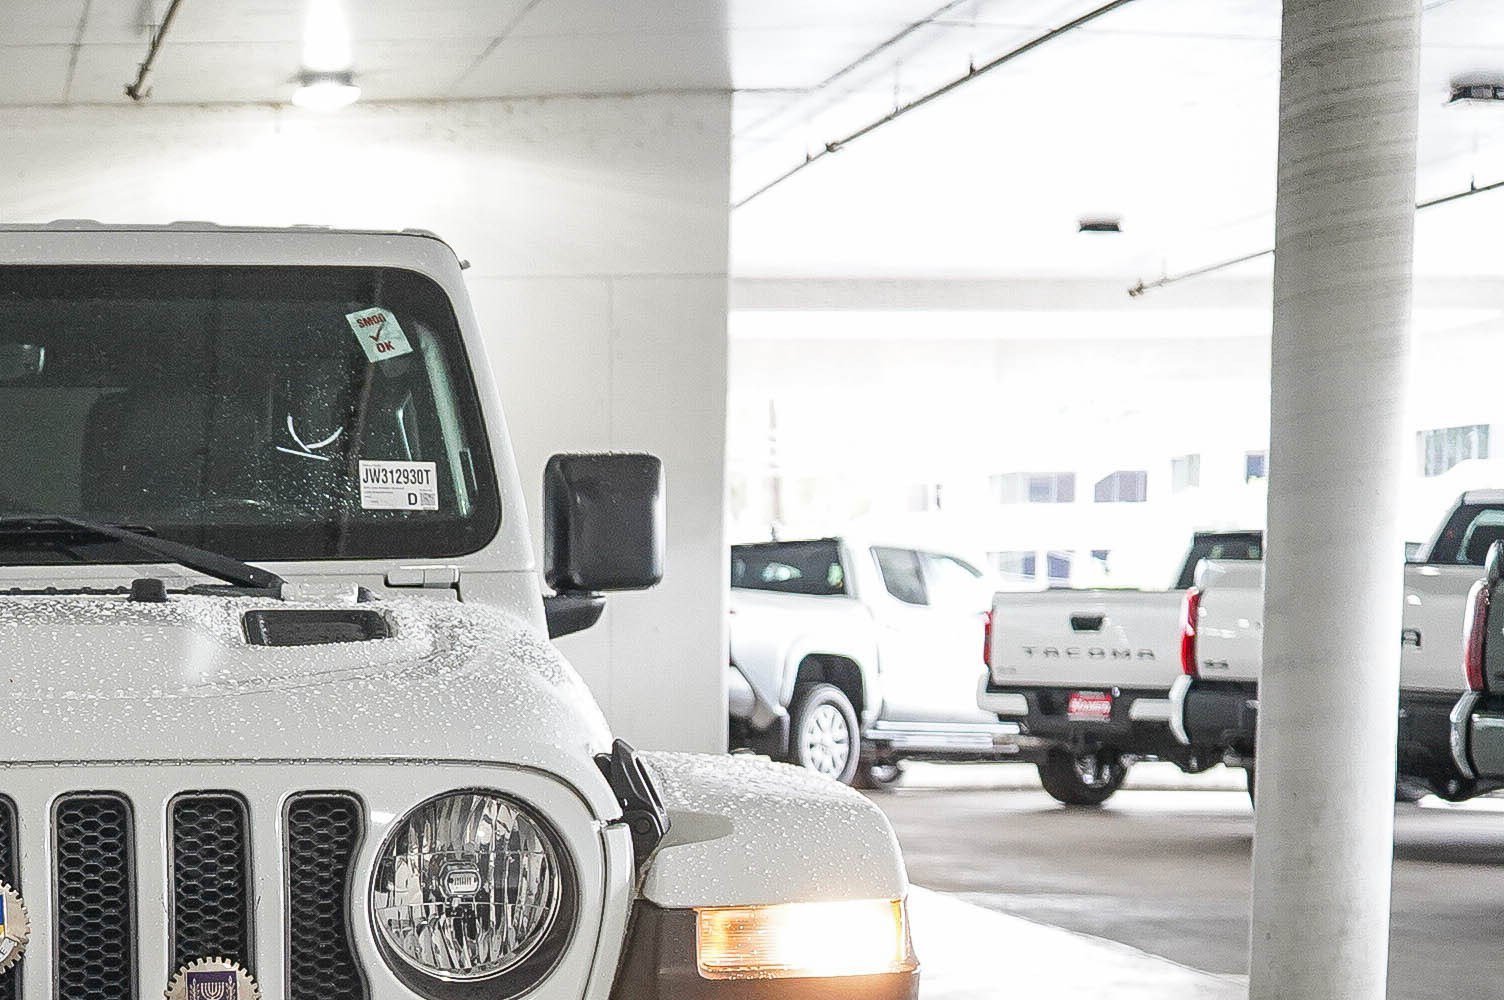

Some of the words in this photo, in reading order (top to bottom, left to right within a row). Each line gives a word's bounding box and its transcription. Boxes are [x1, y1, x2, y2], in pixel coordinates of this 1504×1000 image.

[377, 341, 395, 353] OK
[362, 467, 431, 485] JW312930T
[407, 492, 418, 506] D
[1021, 645, 1157, 661] TACOMA
